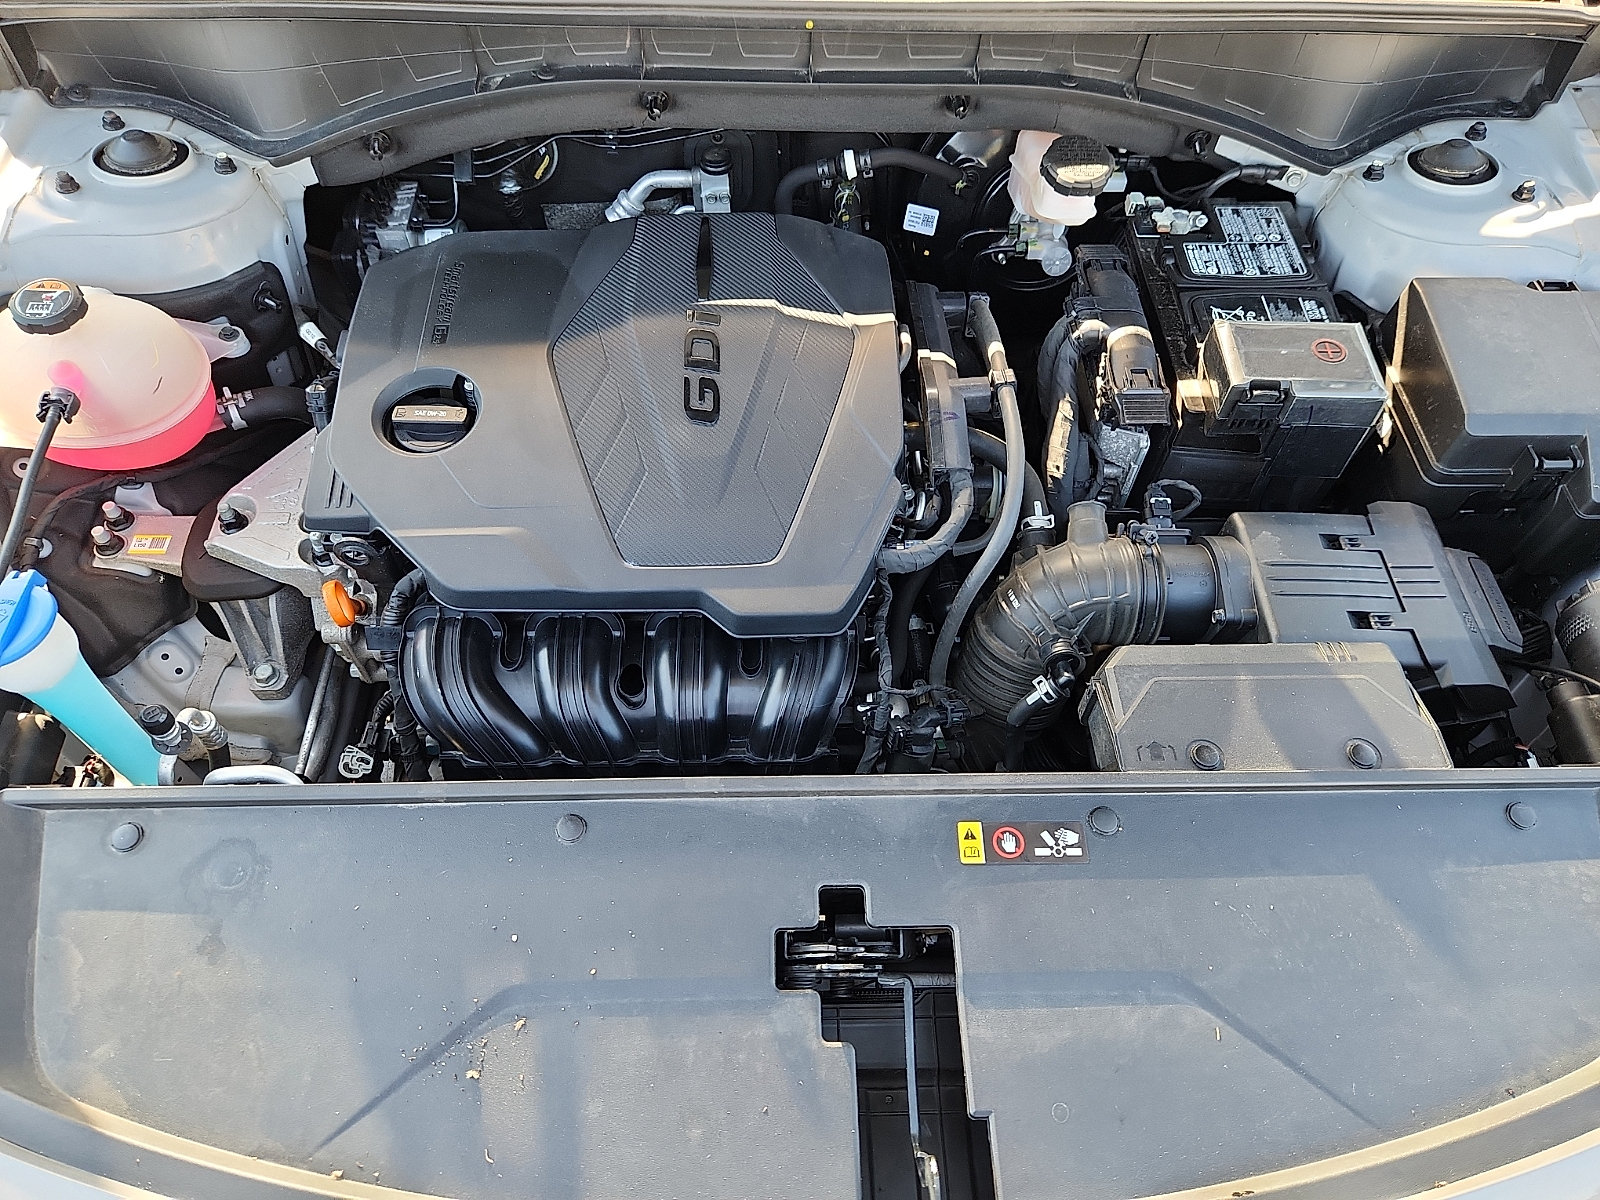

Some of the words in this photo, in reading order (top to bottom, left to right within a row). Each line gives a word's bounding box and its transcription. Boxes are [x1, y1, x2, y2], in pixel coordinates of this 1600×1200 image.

[435, 267, 453, 323] TECHNOLOGY
[443, 260, 466, 324] Smartstream
[683, 308, 721, 426] GDi
[413, 409, 427, 417] SAE
[427, 409, 447, 418] 0W-20
